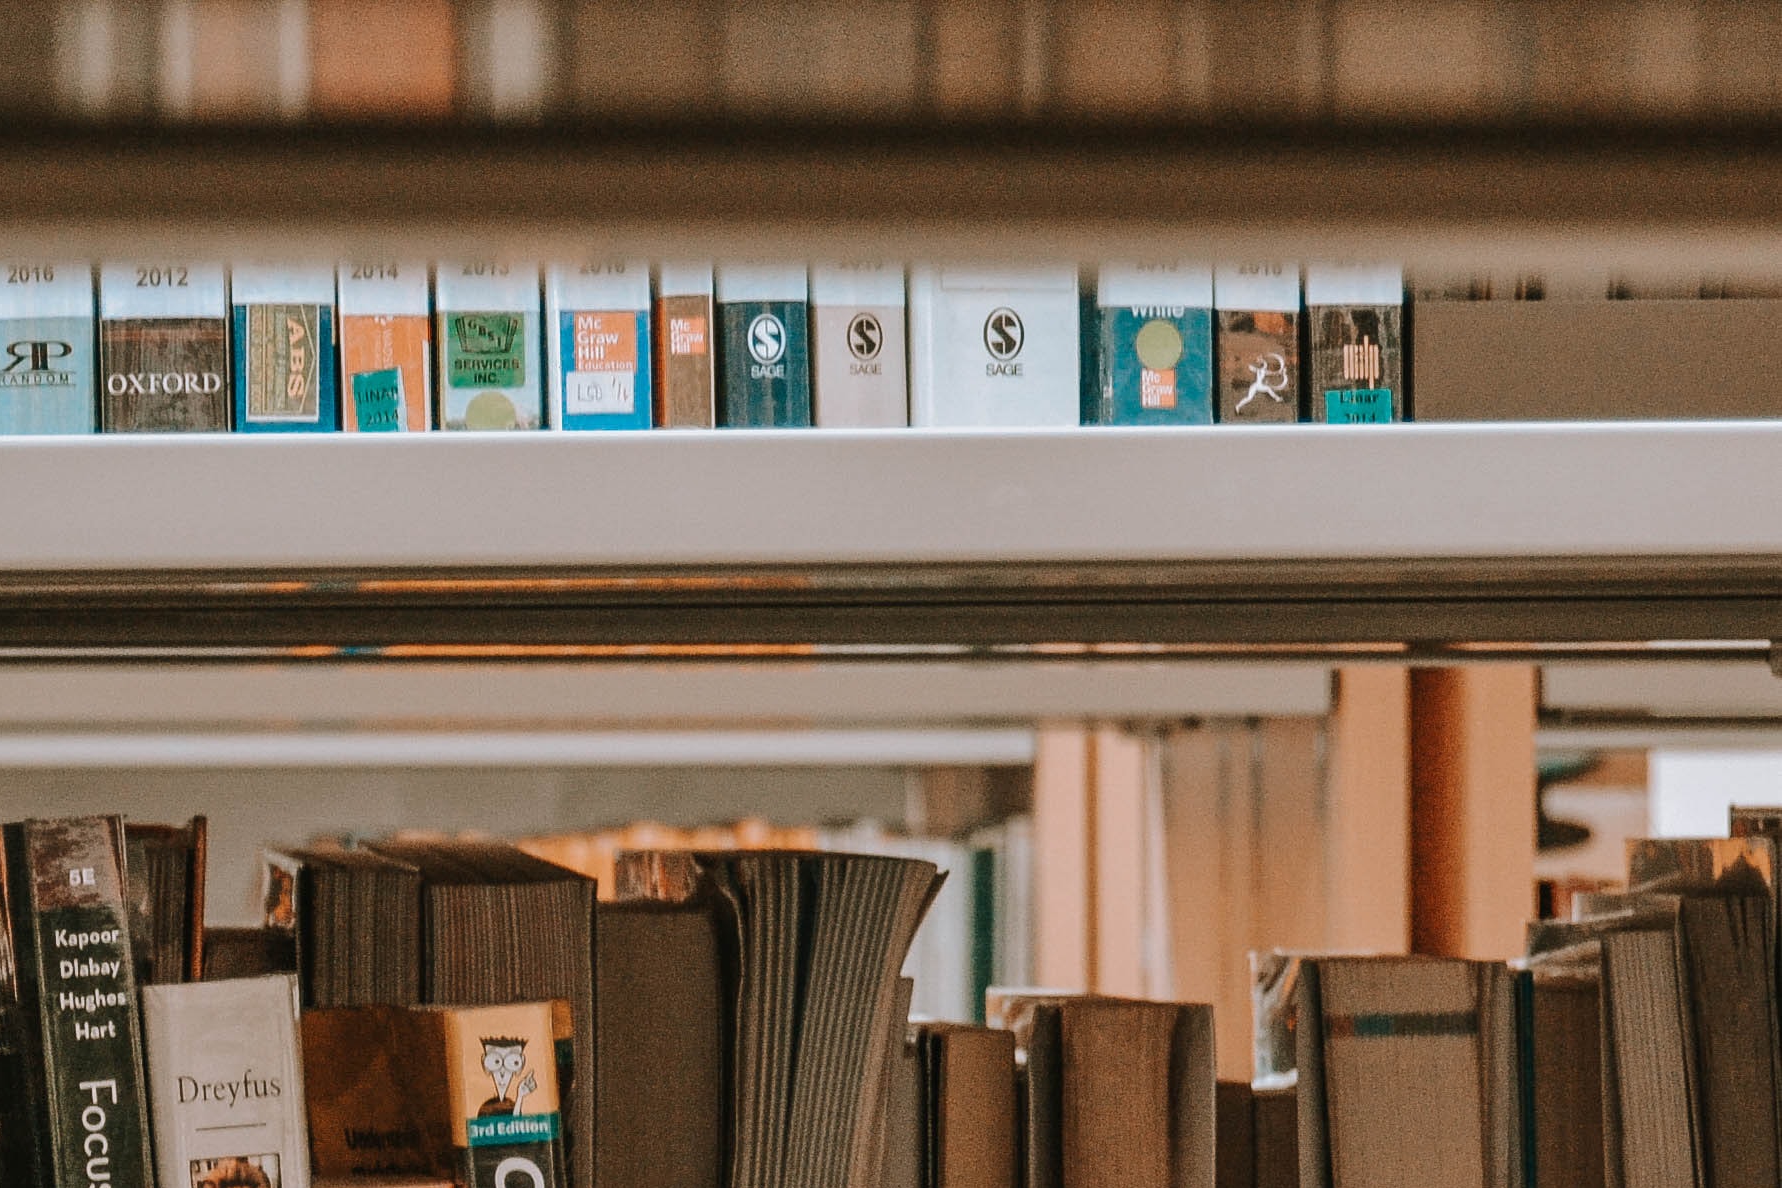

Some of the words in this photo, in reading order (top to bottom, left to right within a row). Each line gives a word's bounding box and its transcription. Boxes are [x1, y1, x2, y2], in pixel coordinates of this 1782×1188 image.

[136, 270, 189, 288] 2012
[577, 315, 603, 330] Mc
[577, 330, 619, 345] Graw
[286, 315, 306, 399] ABS
[577, 344, 606, 360] Hill
[578, 359, 634, 371] Education
[750, 364, 785, 379] SAGE
[849, 363, 882, 377] SAGE
[986, 363, 1024, 377] SAGE
[107, 372, 221, 396] OXFORD
[54, 927, 119, 951] Kapoor
[59, 957, 120, 980] Dlabay
[59, 988, 127, 1013] Hughes
[74, 1020, 117, 1042] Hart
[177, 1068, 282, 1108] Dreyfus
[470, 1123, 495, 1138] 3rd
[497, 1119, 550, 1136] Edition
